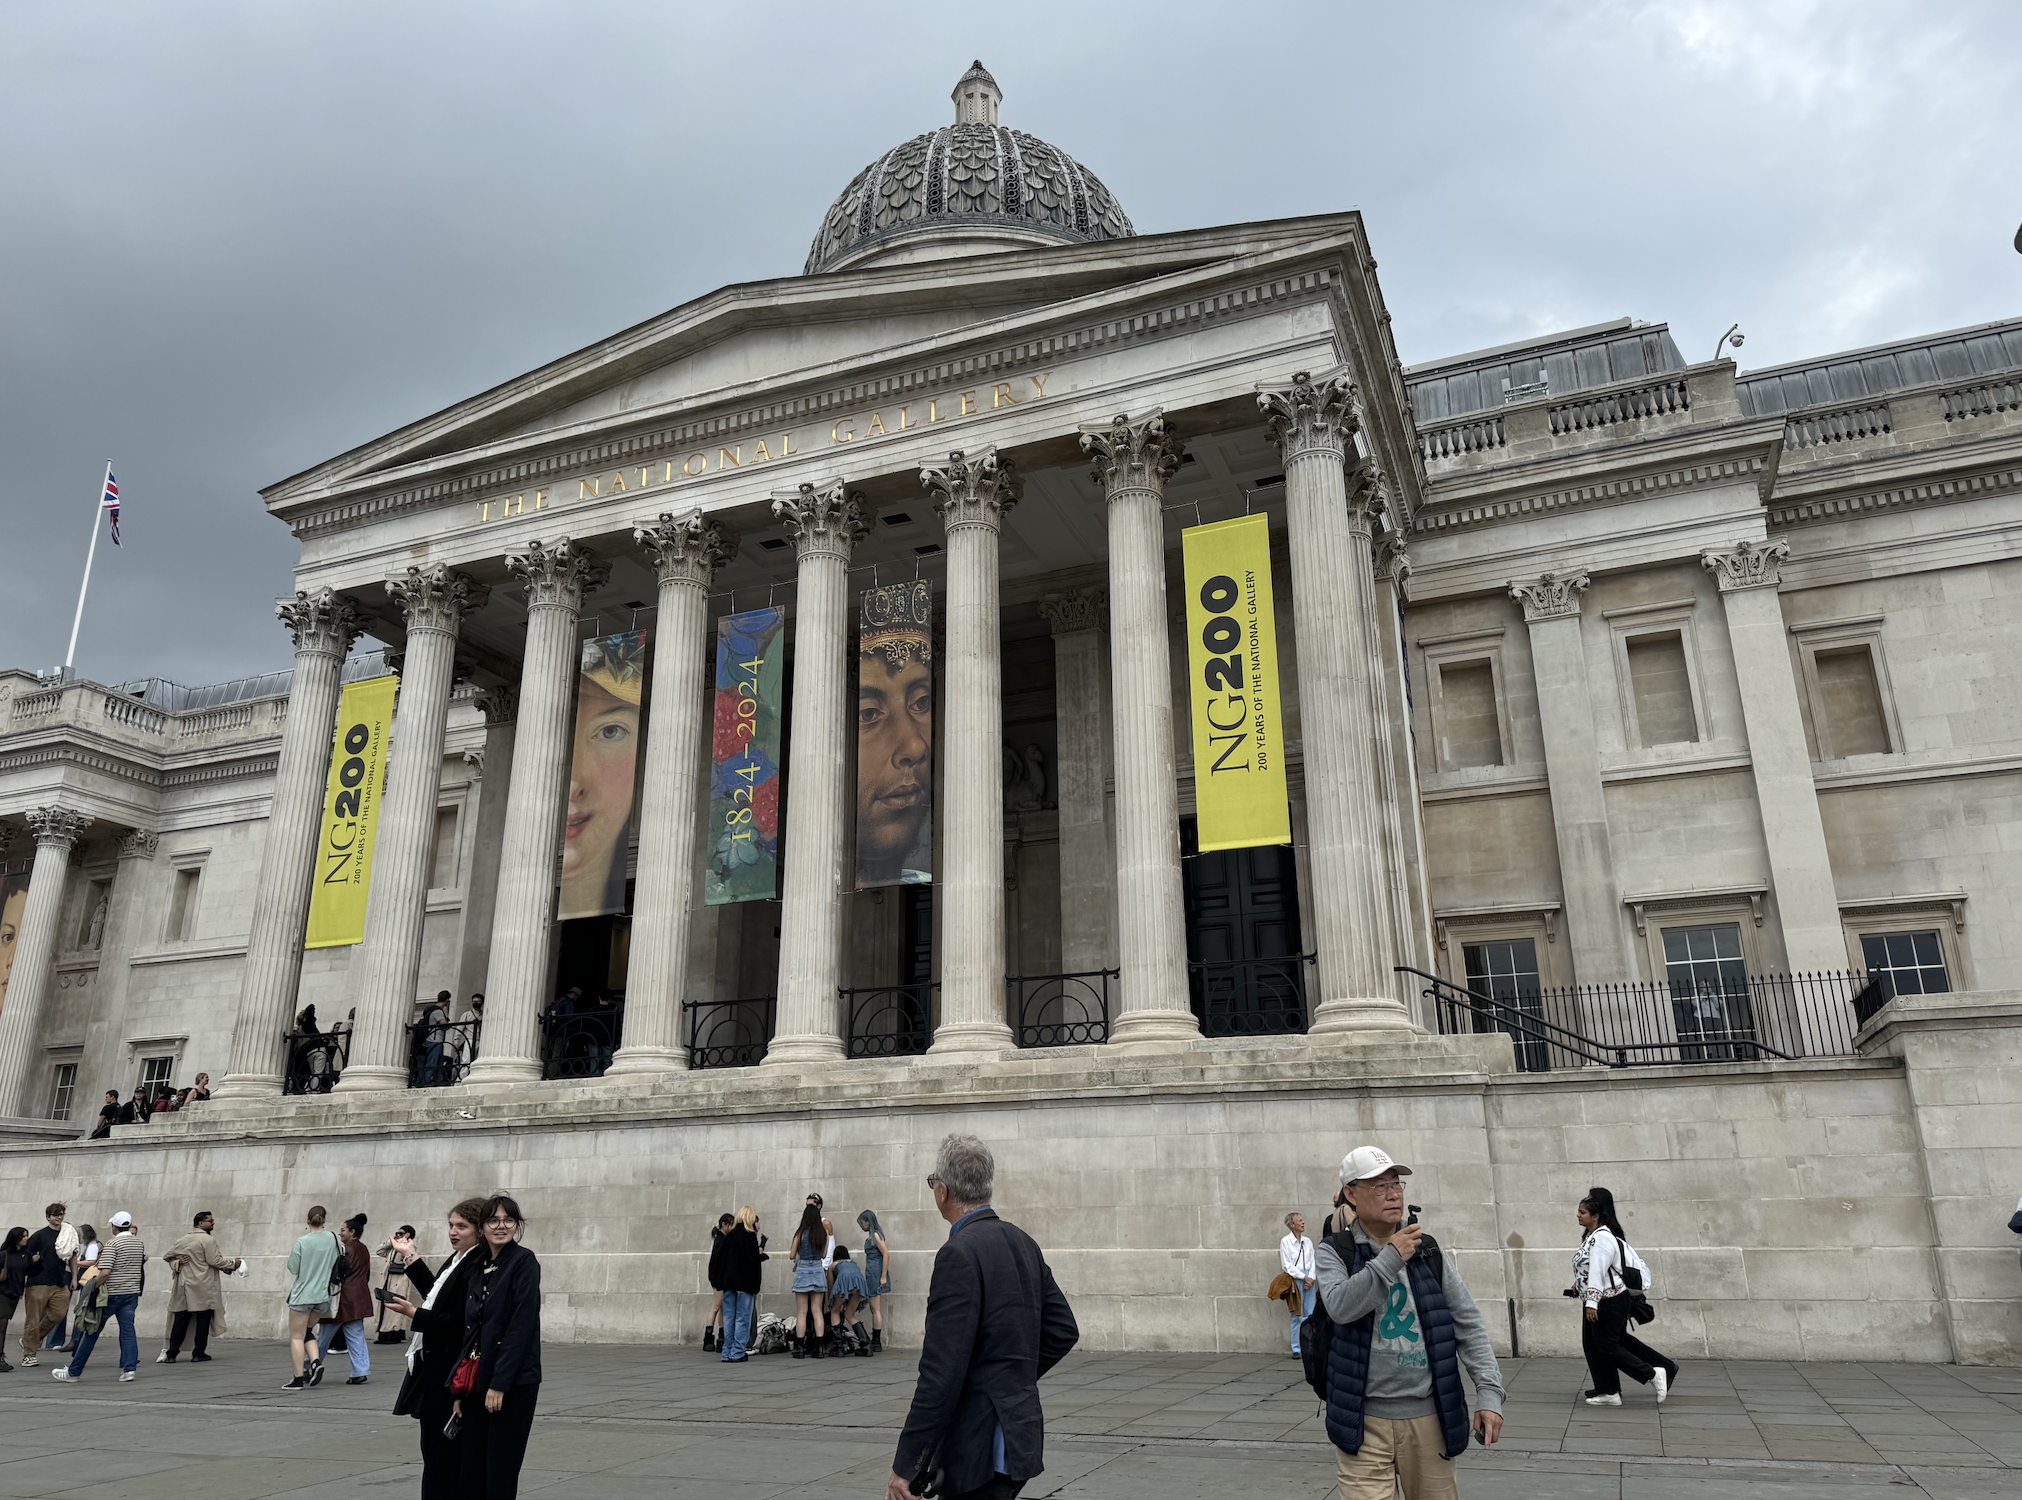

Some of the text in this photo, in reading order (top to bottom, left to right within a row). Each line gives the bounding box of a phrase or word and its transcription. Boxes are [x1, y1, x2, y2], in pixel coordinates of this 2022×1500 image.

[475, 371, 1054, 523] THE NATIONAL GALLERY
[1200, 575, 1250, 777] NG200
[1245, 570, 1268, 771] 200 YEARS OF THE NATIONAL GALLERY
[323, 723, 369, 888] NG200
[353, 720, 382, 885] 200 YEARS OF THE NATIONAL GALLERY
[1380, 1282, 1419, 1343] &
